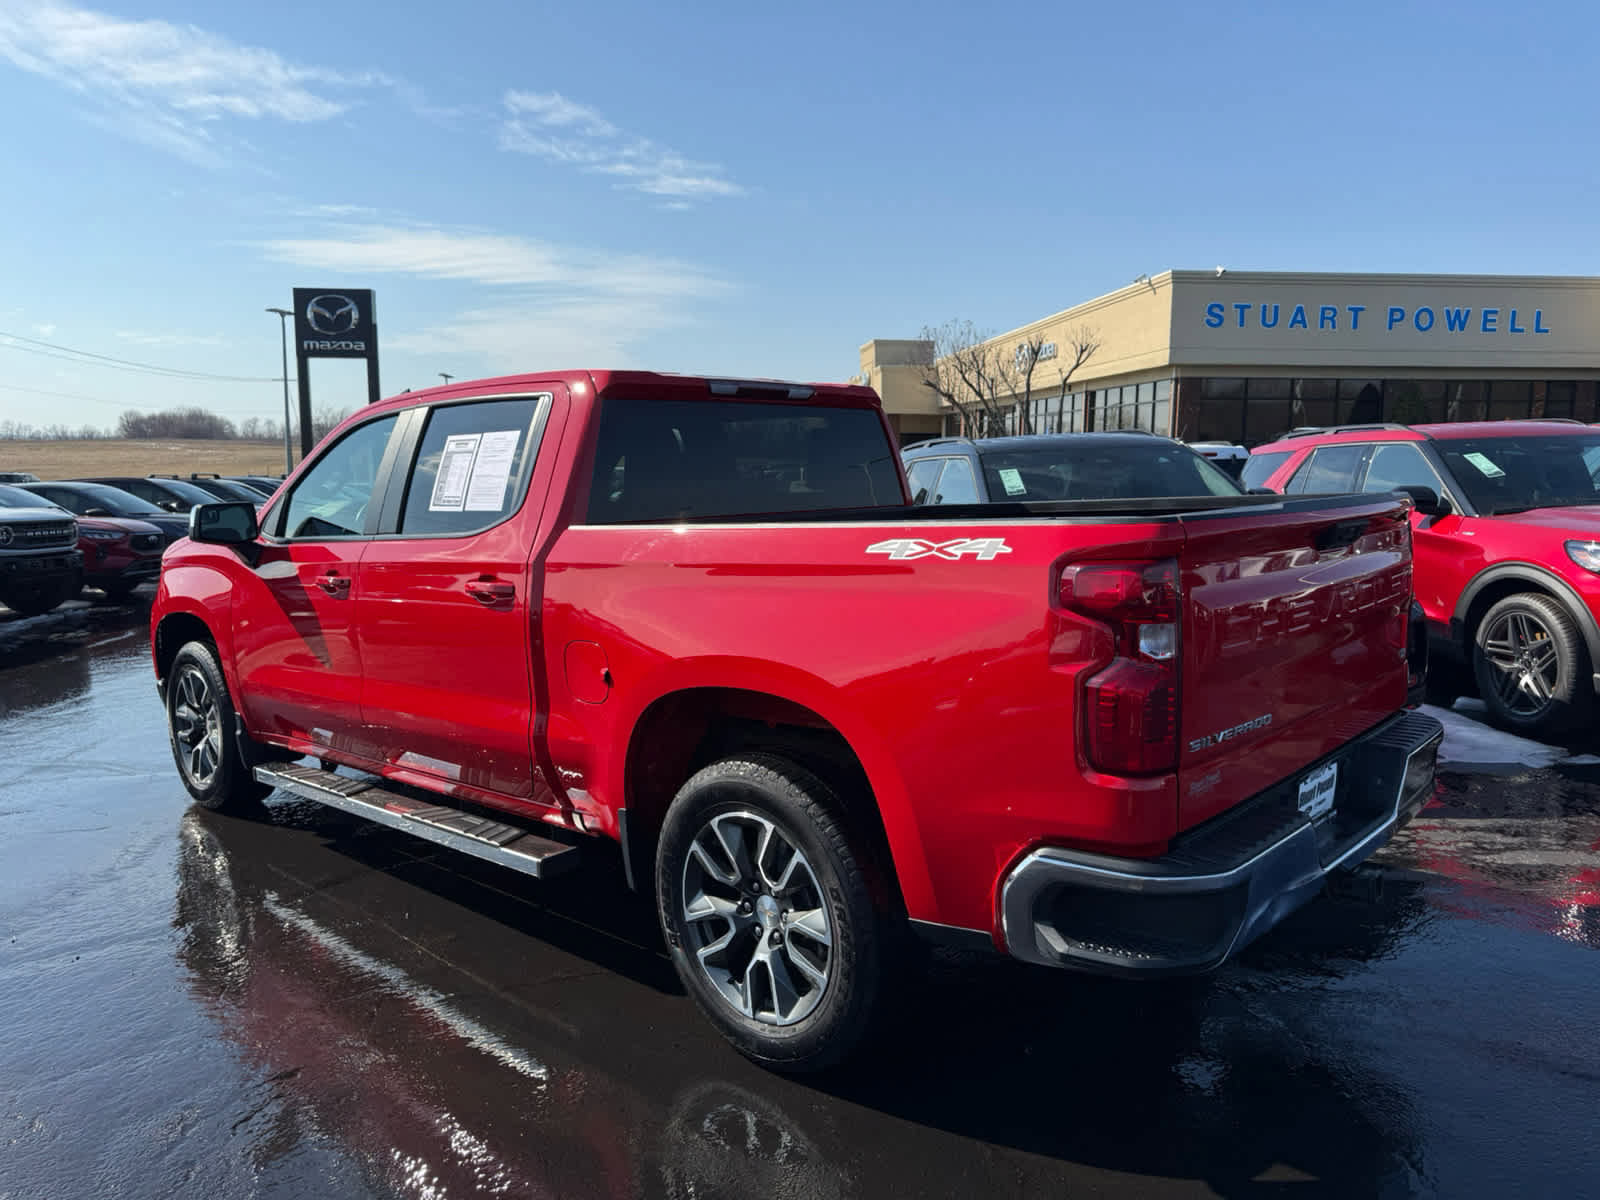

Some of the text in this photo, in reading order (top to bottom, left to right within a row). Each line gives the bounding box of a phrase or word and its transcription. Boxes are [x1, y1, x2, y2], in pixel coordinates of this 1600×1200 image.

[1204, 302, 1551, 334] STUART POWELL
[303, 339, 366, 351] mazda
[1187, 712, 1273, 753] SILVERADO
